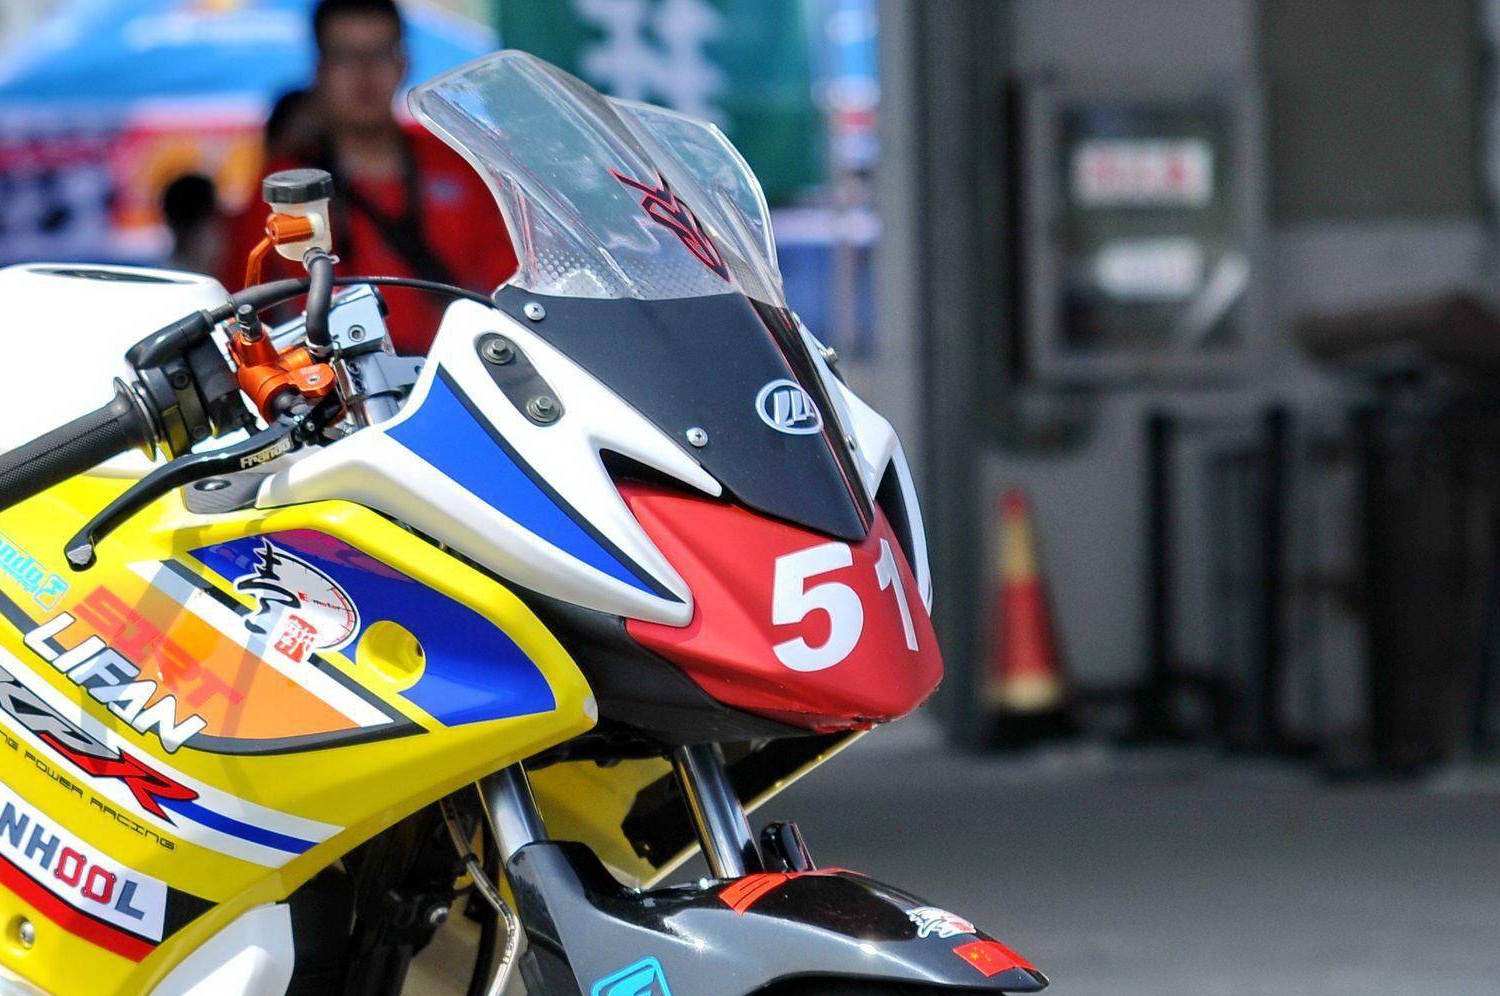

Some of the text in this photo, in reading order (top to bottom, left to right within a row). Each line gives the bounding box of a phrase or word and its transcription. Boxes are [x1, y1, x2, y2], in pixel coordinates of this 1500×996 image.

[772, 538, 920, 673] 51
[23, 612, 208, 753] LIFAN
[24, 750, 84, 800] POWER
[89, 796, 176, 852] RACING
